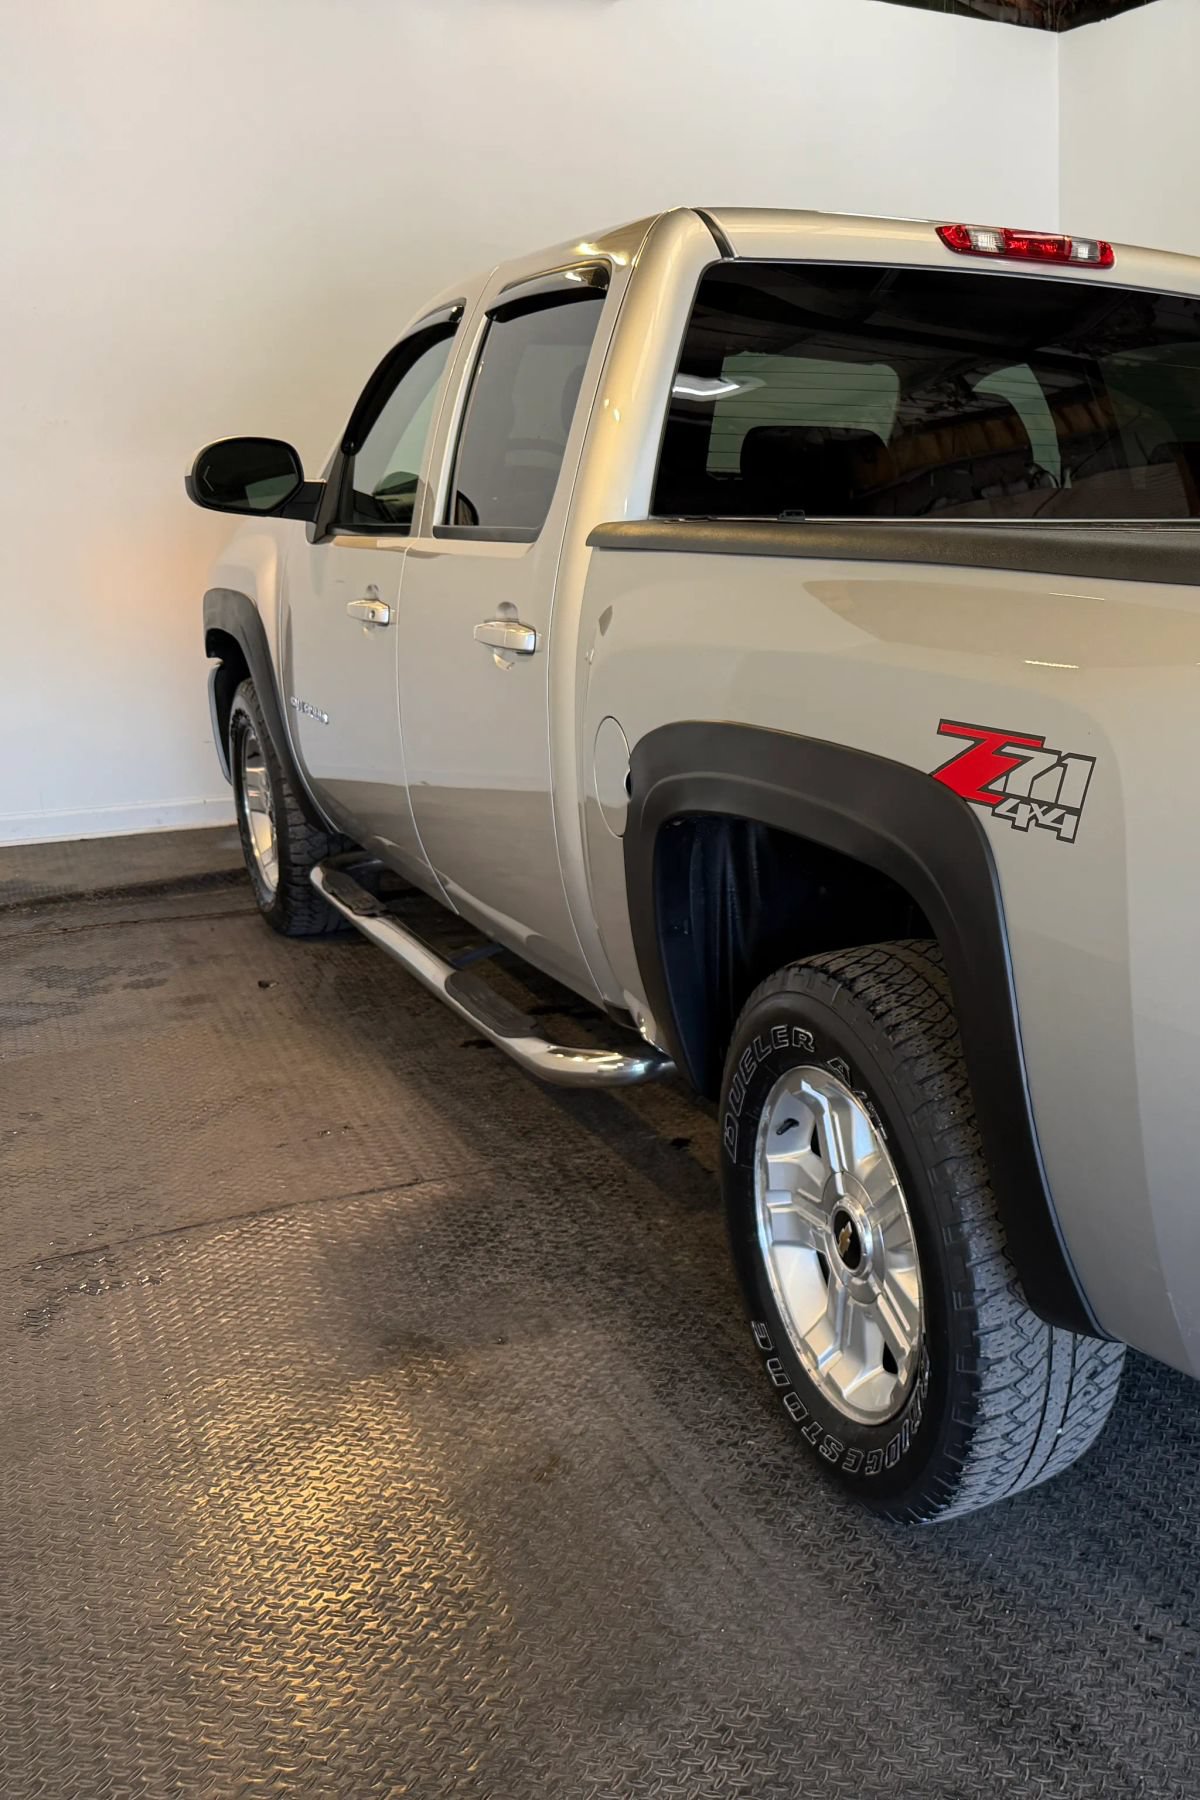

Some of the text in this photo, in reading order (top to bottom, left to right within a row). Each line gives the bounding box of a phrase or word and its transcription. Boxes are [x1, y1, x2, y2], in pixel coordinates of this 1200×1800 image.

[929, 719, 1096, 810] Z71
[724, 1024, 815, 1164] DUELER
[751, 1320, 930, 1476] BRIDGESTONE
